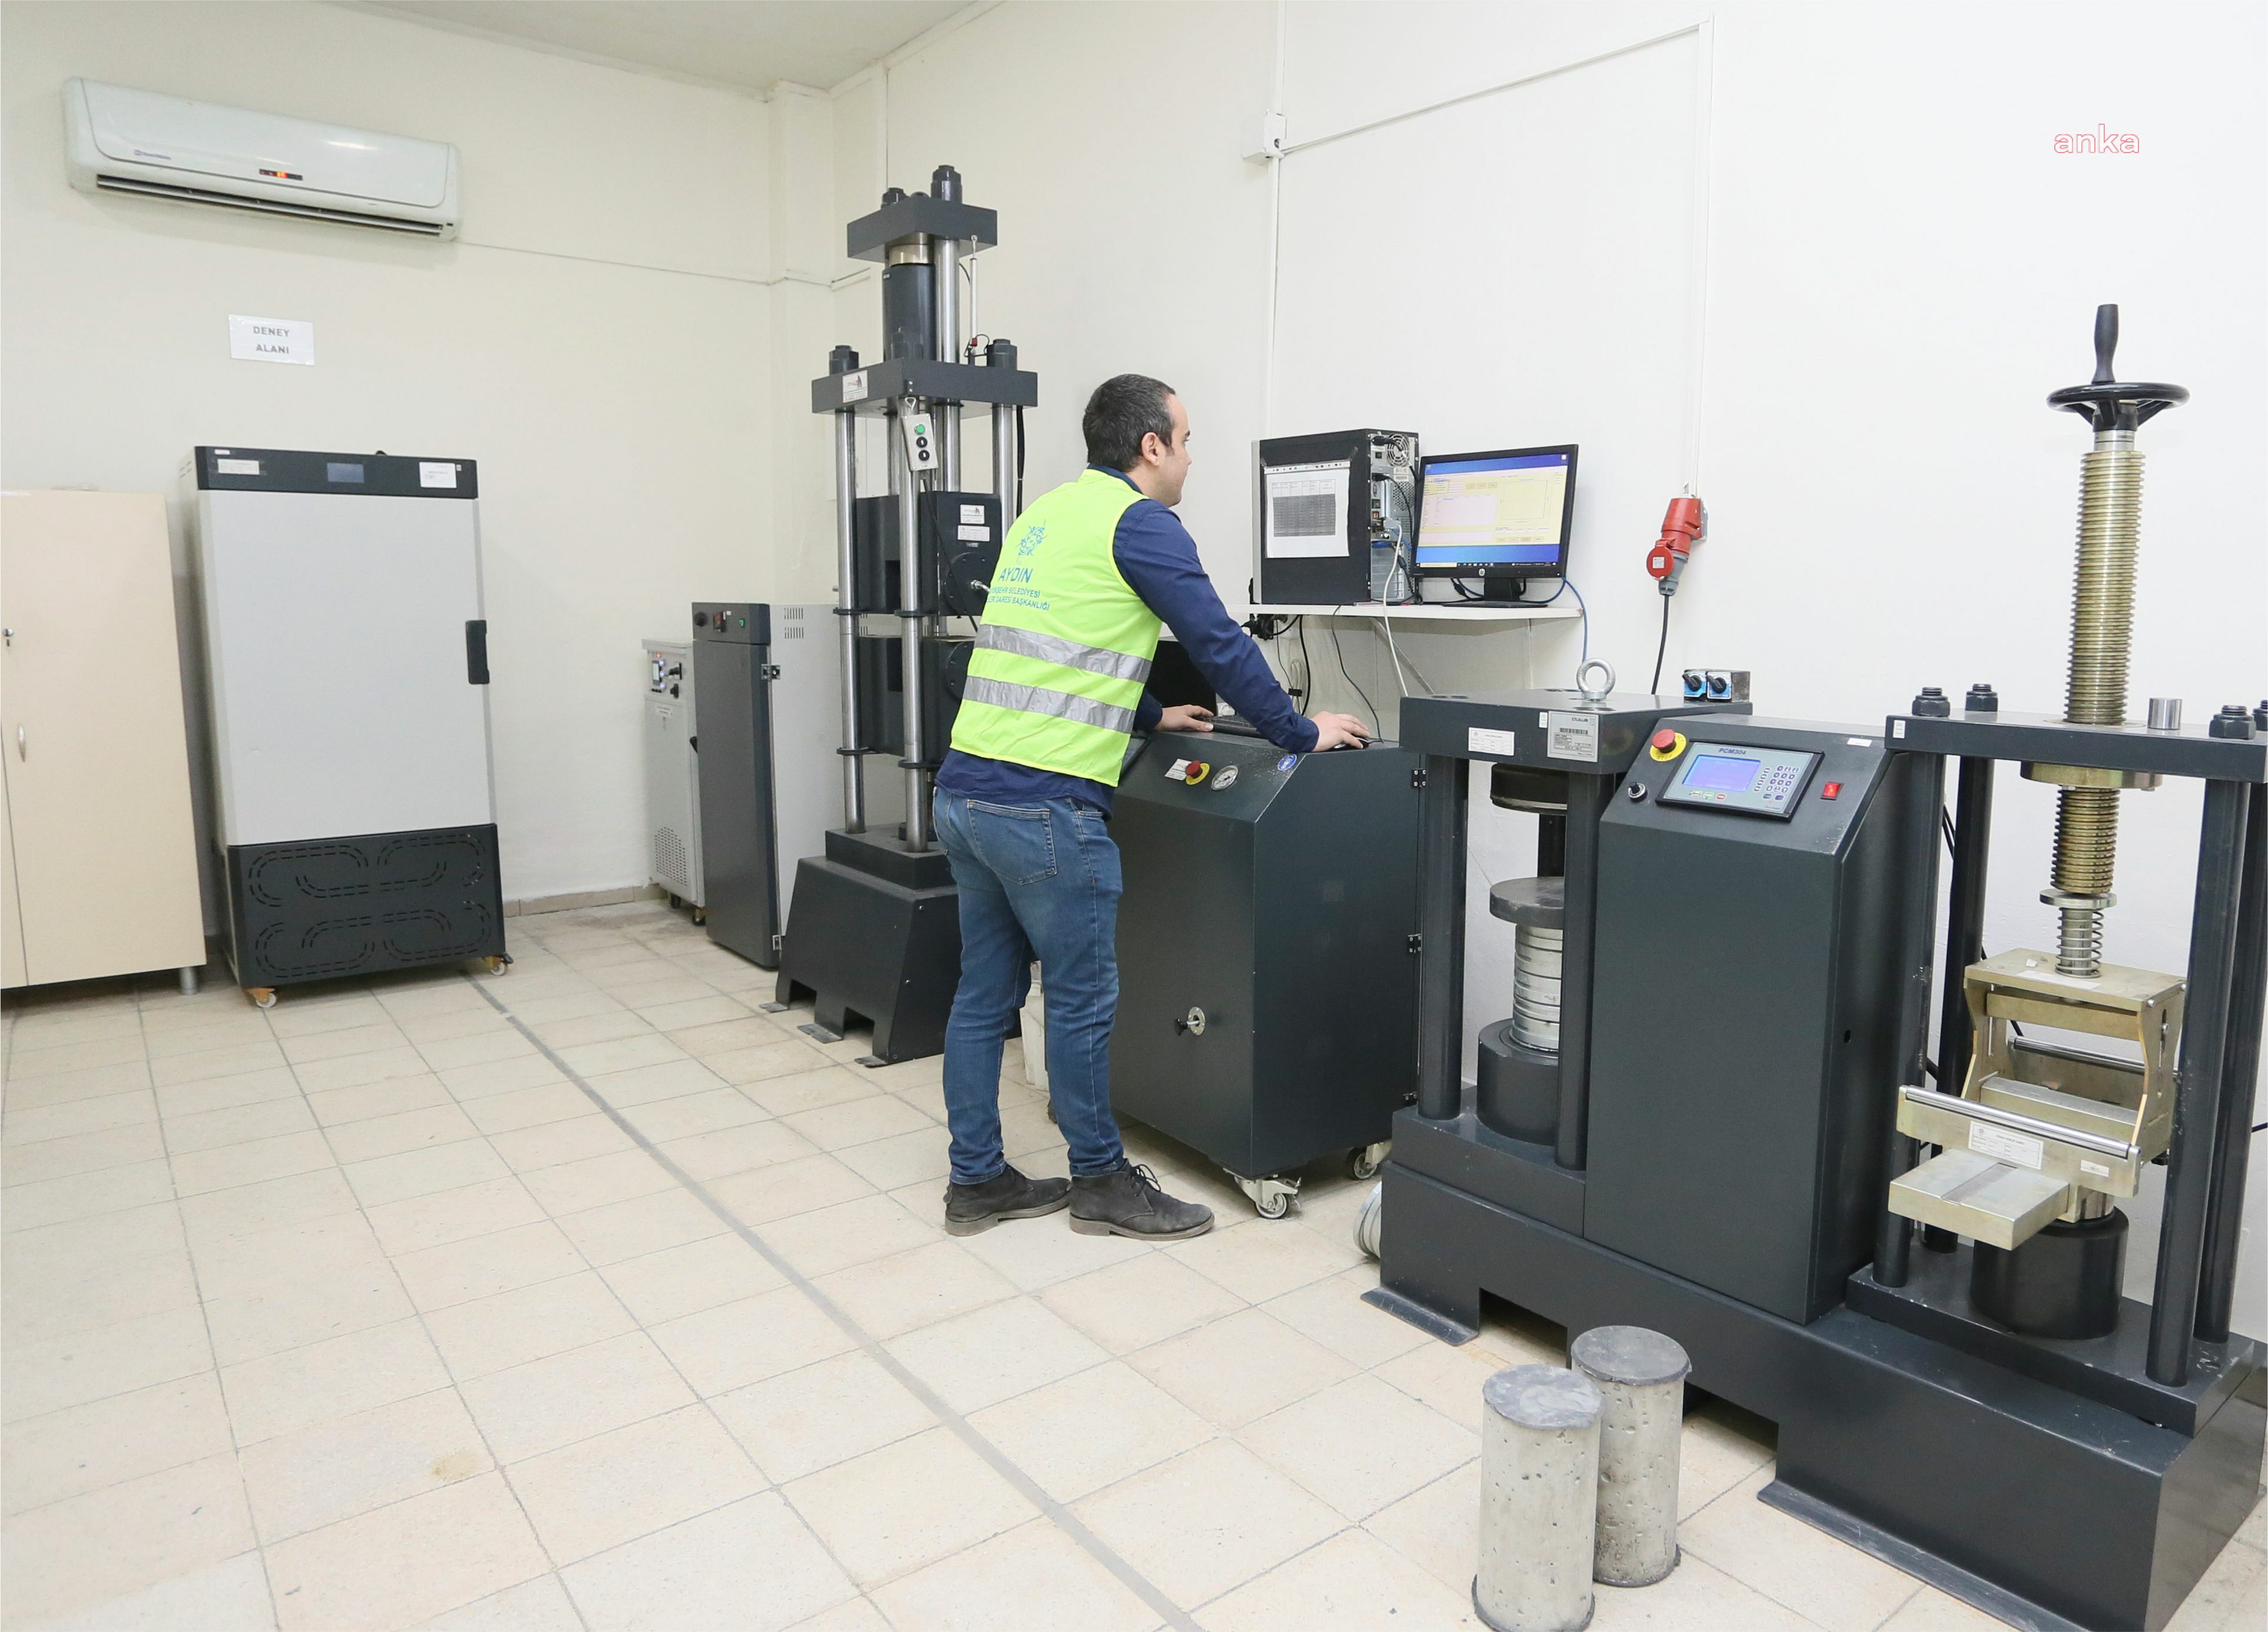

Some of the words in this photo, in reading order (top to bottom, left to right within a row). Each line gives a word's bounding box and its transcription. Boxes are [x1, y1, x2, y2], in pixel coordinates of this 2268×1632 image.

[253, 326, 290, 337] DENEY
[256, 344, 289, 355] ALANI
[998, 567, 1033, 582] AYDIN
[1008, 587, 1041, 598] BELEDİYESİ
[1012, 597, 1050, 611] BAŞKANLIĞI
